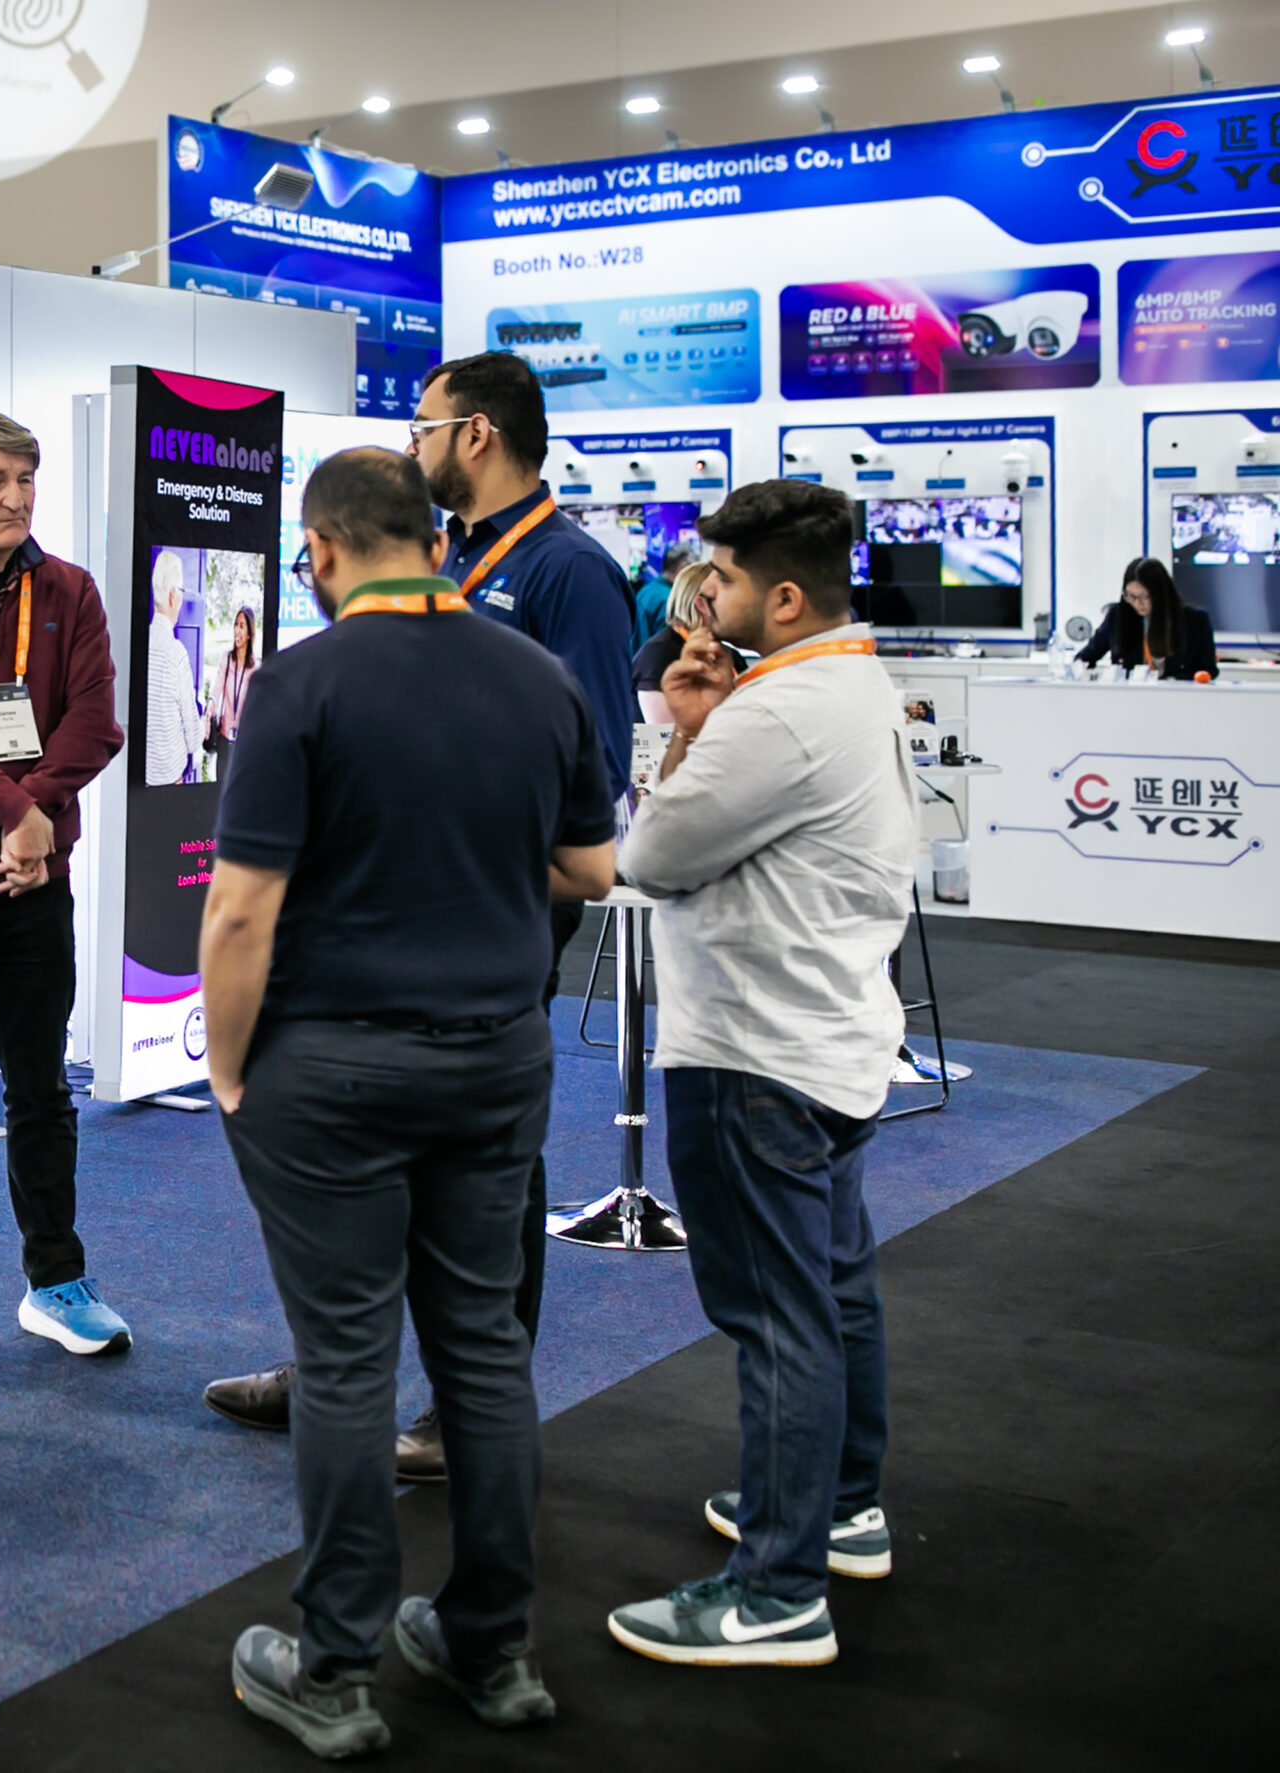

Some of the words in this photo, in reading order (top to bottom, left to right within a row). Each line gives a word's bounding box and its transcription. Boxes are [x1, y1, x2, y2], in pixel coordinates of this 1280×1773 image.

[493, 174, 597, 202] Shenzhen
[604, 165, 650, 191] YCX
[657, 148, 787, 185] Electronics
[851, 139, 890, 163] Ltd
[493, 183, 740, 227] www.ycxcctvcam.com
[275, 210, 298, 232] YCX
[299, 215, 370, 245] ELECTRONICS
[493, 254, 551, 276] Booth
[1135, 289, 1221, 309] 6MP/8MP
[638, 303, 702, 322] SMART
[809, 307, 848, 325] RED
[850, 306, 862, 322] &
[866, 303, 917, 321] BLUE
[1136, 309, 1183, 324] AUTO
[1188, 303, 1277, 320] TRACKING
[157, 478, 215, 502] Emergency
[216, 485, 224, 501] &
[225, 485, 263, 506] Distress
[189, 503, 230, 523] Solution
[1136, 815, 1238, 840] YCX
[180, 840, 204, 853] Mobile
[177, 875, 197, 887] Lone
